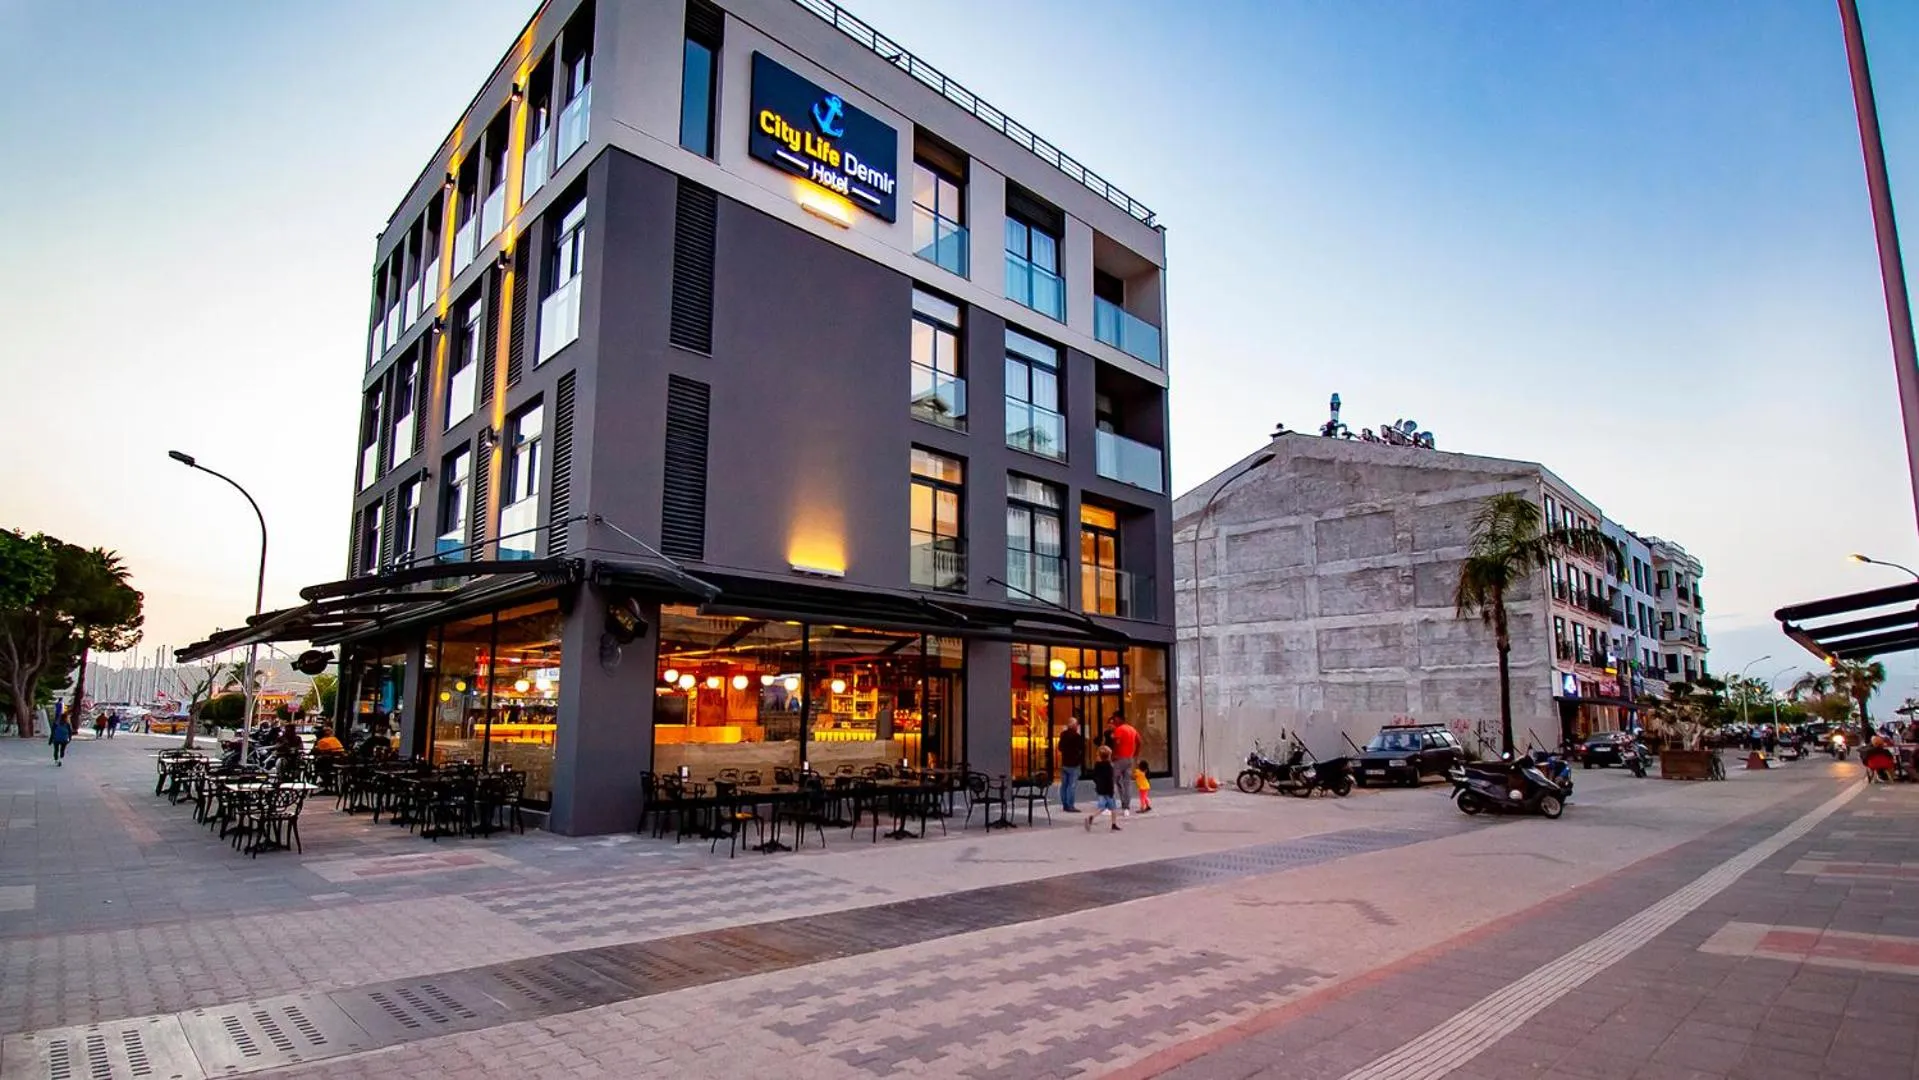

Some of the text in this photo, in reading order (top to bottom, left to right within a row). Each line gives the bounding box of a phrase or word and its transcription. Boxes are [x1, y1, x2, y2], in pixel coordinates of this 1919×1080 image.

[760, 110, 895, 194] City Life Demir
[812, 161, 849, 193] Hotel
[1083, 669, 1099, 680] Life
